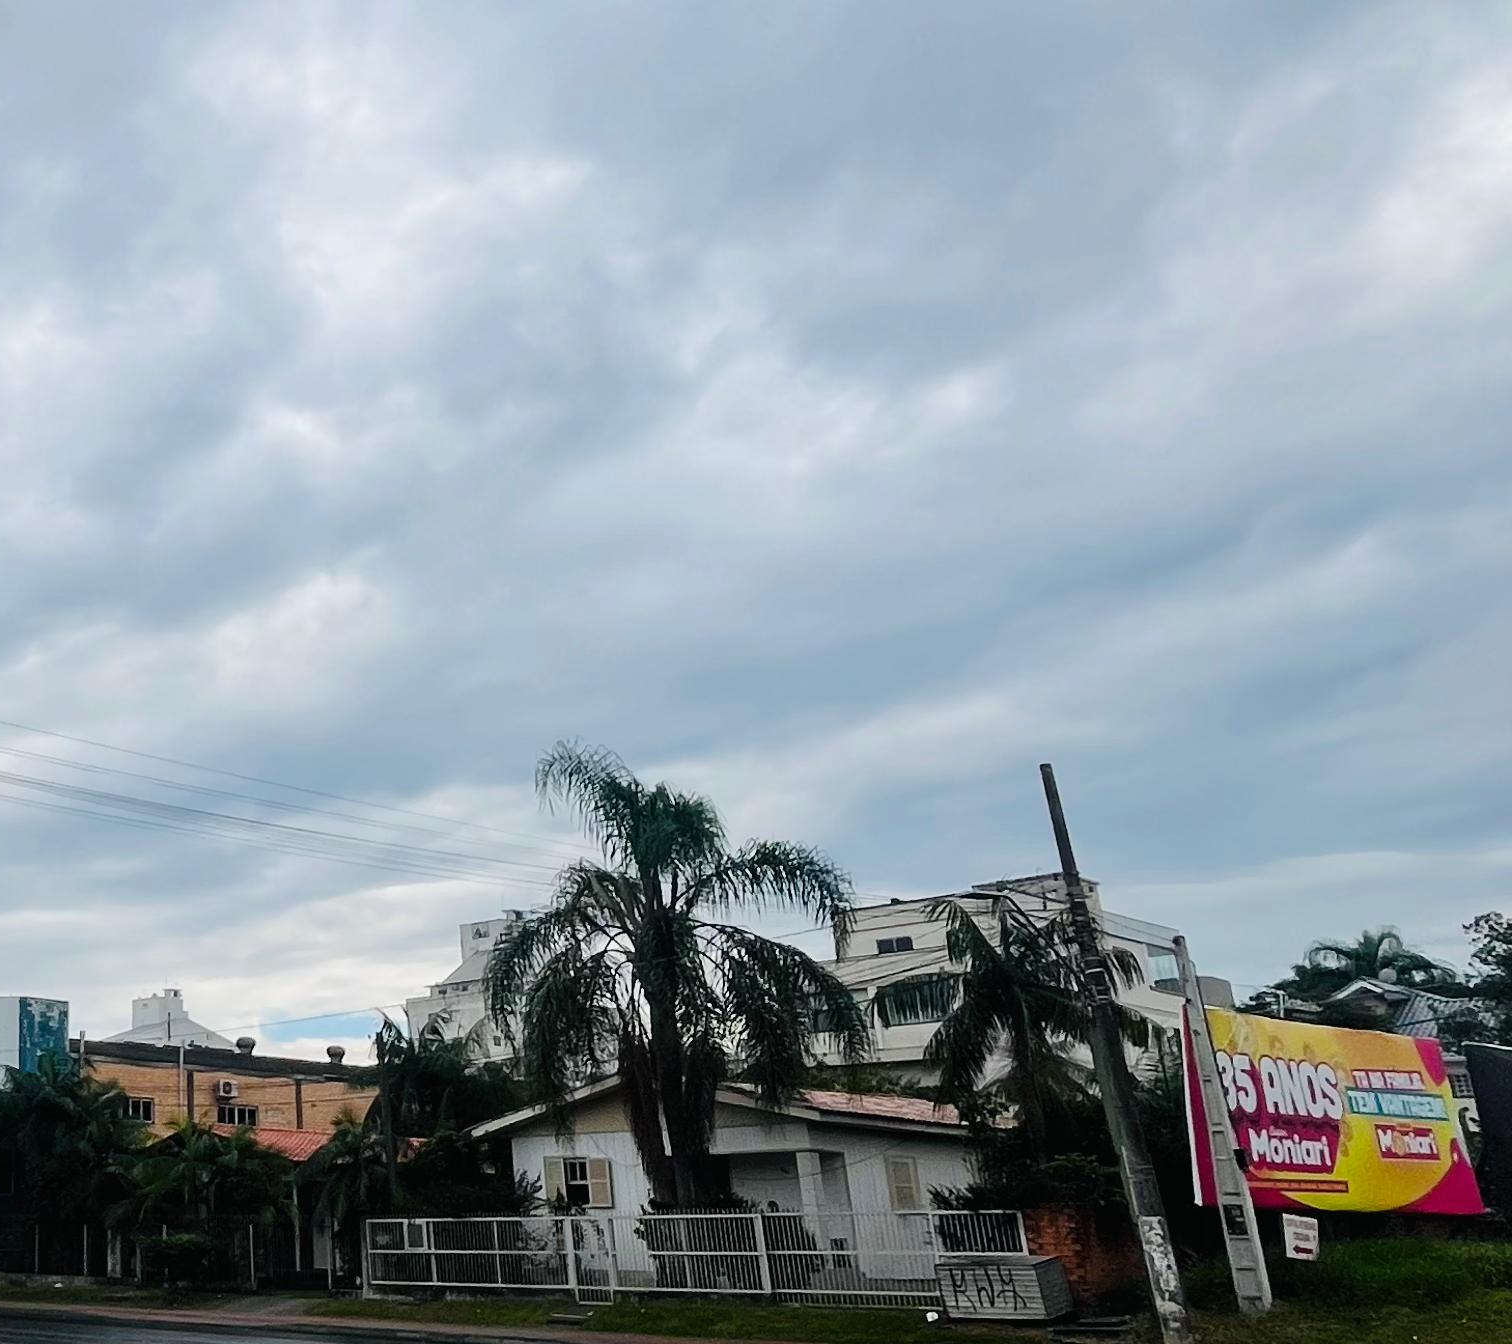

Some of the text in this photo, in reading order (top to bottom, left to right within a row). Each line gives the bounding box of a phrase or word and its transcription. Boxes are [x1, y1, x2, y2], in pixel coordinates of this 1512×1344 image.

[1259, 1056, 1344, 1120] ANOS
[1248, 1128, 1331, 1166] Moniari
[1377, 1129, 1437, 1155] Mniari
